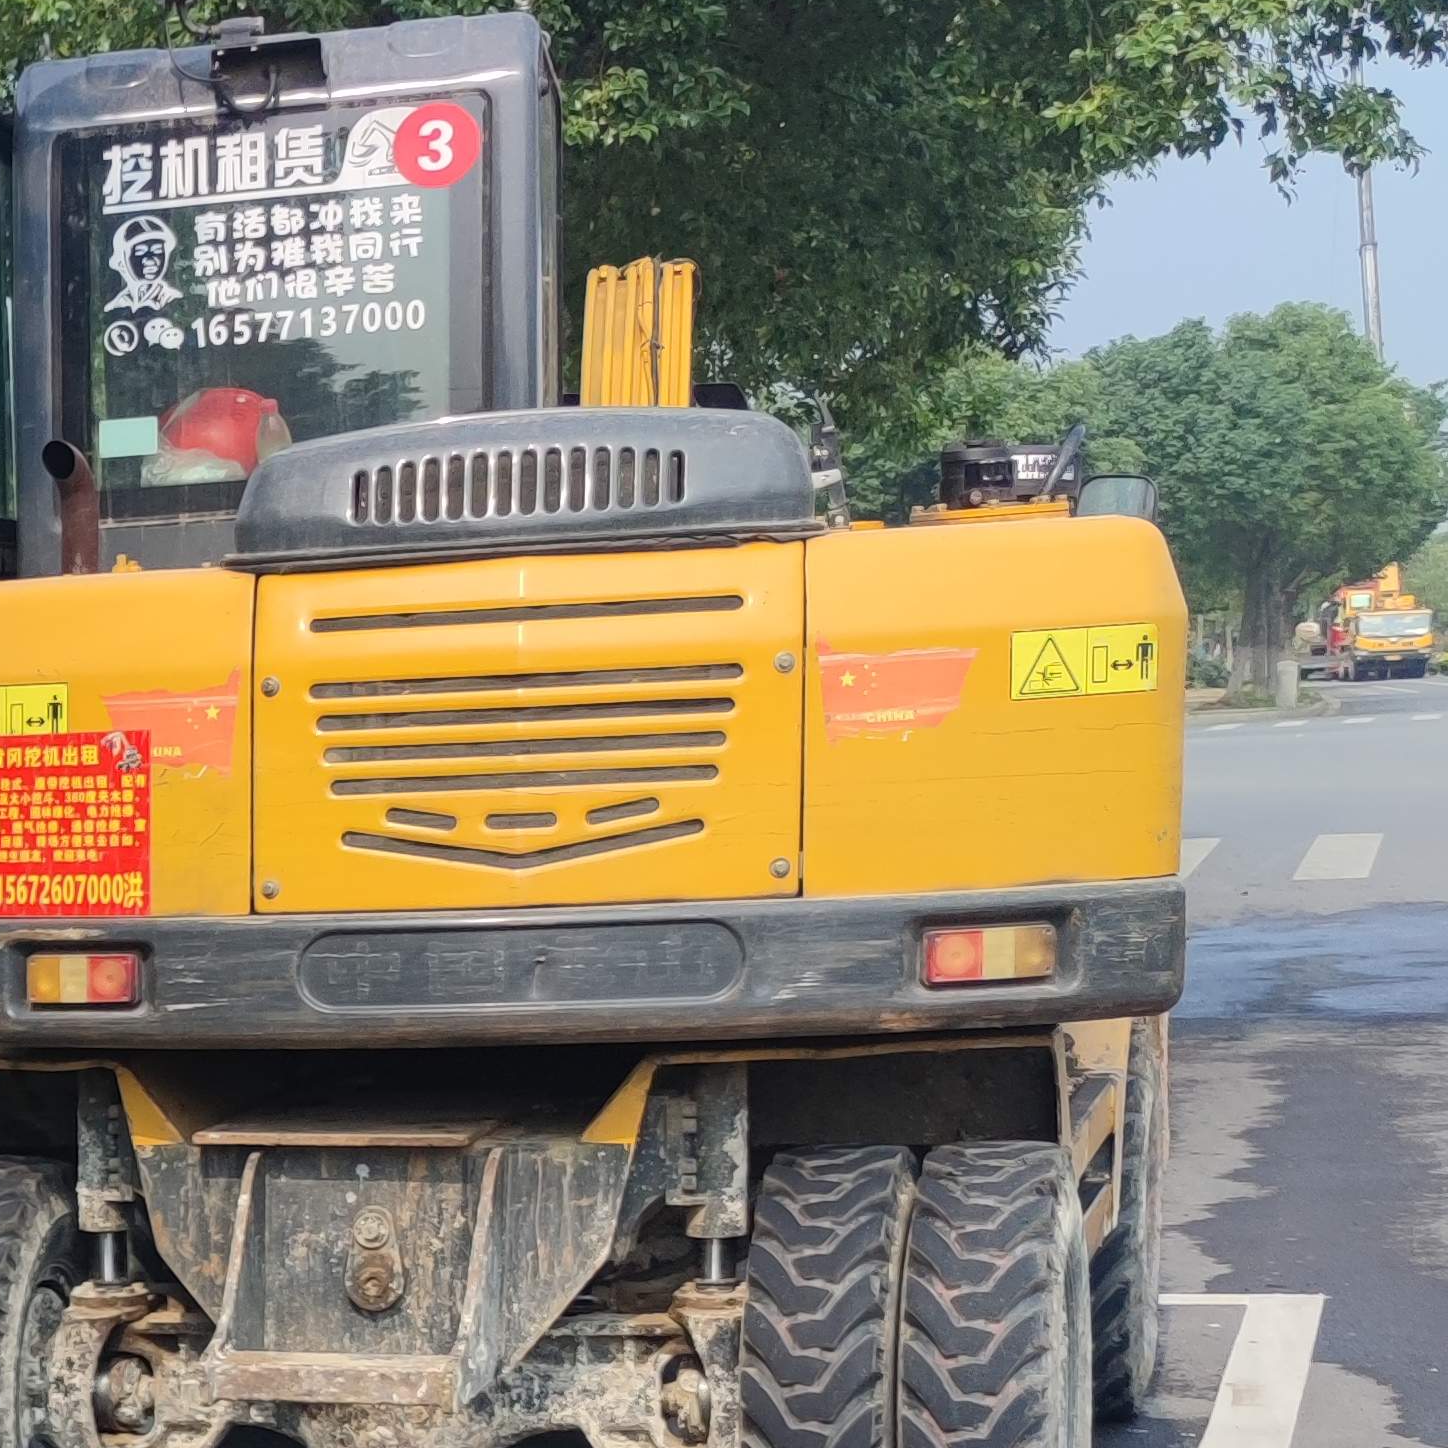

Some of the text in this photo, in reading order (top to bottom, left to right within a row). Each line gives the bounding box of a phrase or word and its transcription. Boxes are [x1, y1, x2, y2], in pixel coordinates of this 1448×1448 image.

[102, 124, 323, 205] 挖机租赁
[417, 119, 454, 171] 3
[194, 193, 423, 244] 有活都冲我来
[207, 262, 396, 307] 他们很辛苦
[191, 299, 425, 348] 16577137000
